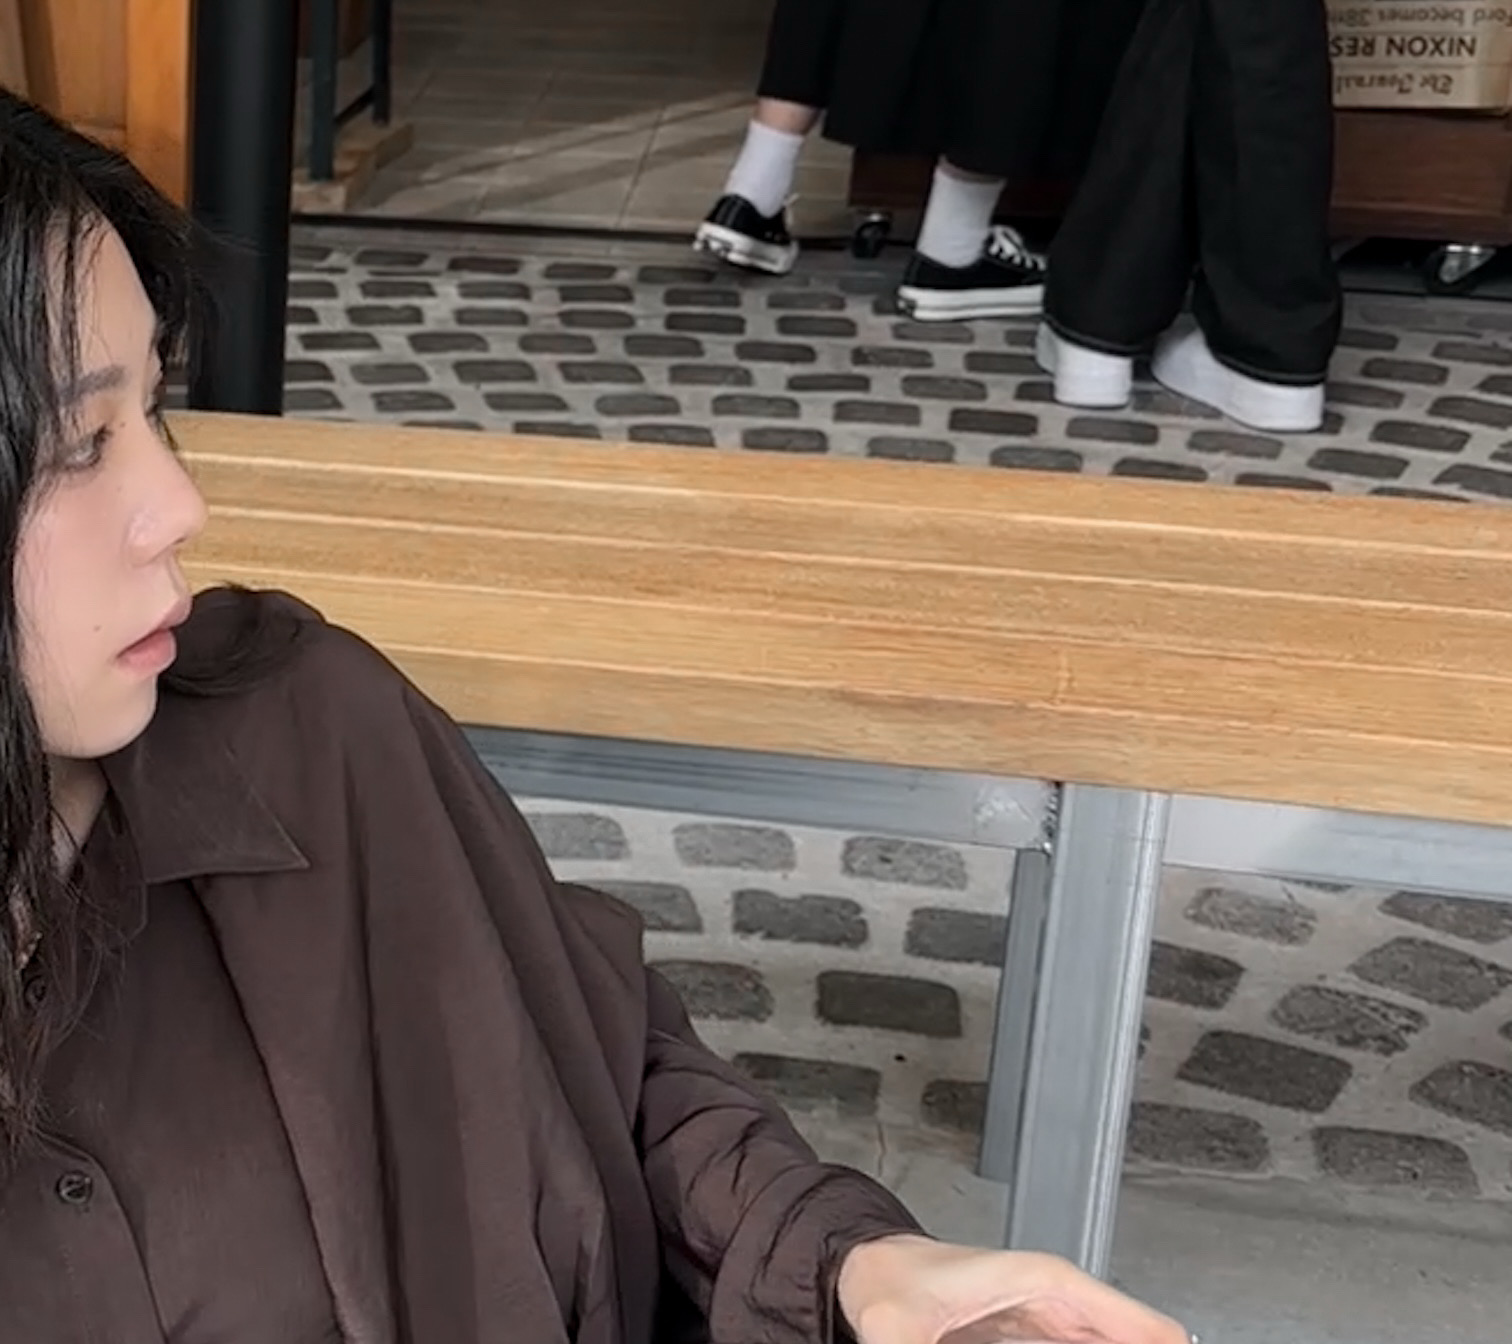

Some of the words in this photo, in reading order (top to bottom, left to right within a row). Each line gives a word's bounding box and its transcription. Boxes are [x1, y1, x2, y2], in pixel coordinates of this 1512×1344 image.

[1378, 7, 1465, 27] becomes
[1386, 36, 1477, 57] NIXON
[1337, 73, 1414, 95] Journal
[1420, 74, 1453, 95] The
